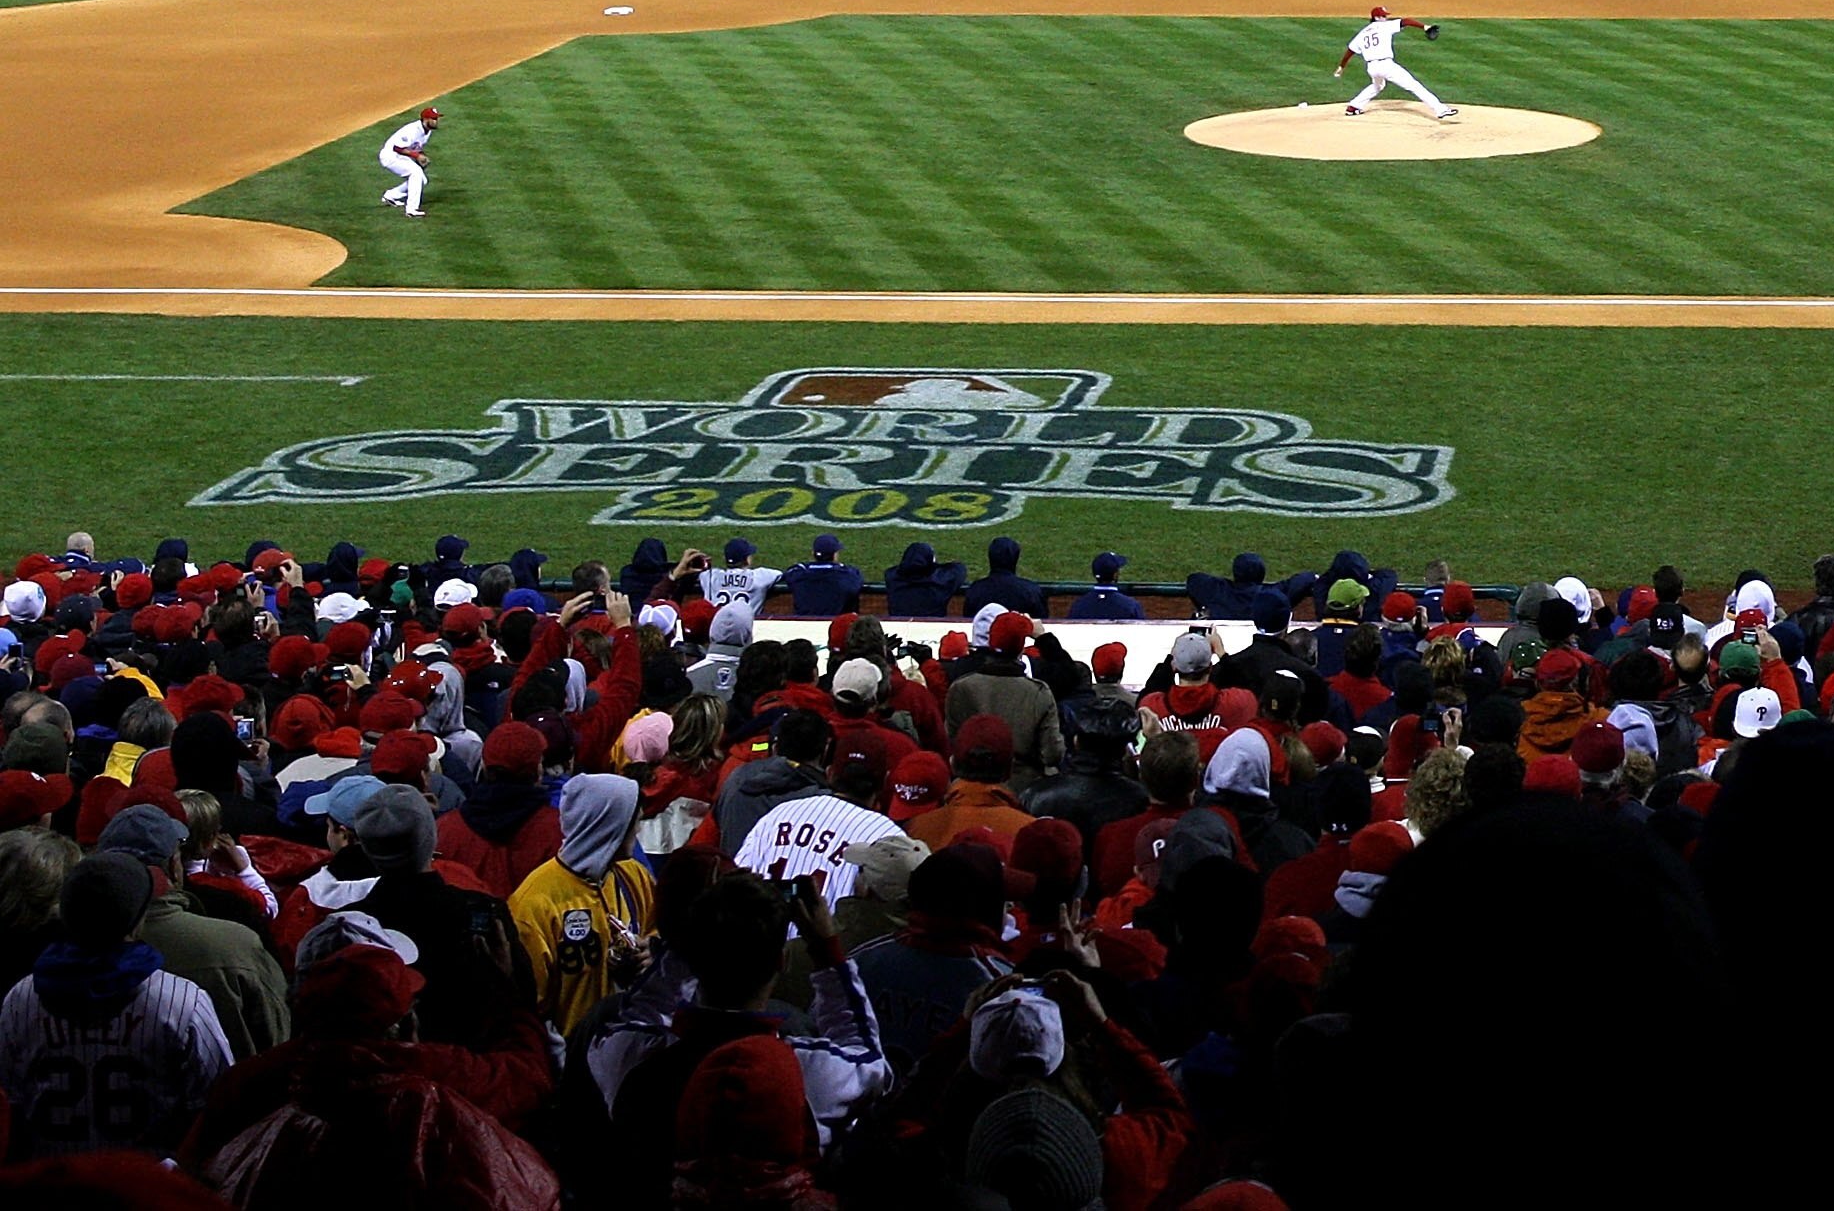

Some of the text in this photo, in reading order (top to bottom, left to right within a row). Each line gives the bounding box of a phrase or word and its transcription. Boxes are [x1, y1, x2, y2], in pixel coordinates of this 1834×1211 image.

[1363, 32, 1380, 49] 35
[522, 404, 1285, 447] WORLD
[230, 436, 1427, 510] SERIES
[632, 487, 990, 522] 2008
[721, 574, 748, 588] JASO
[1756, 706, 1767, 721] P
[1152, 838, 1166, 860] P
